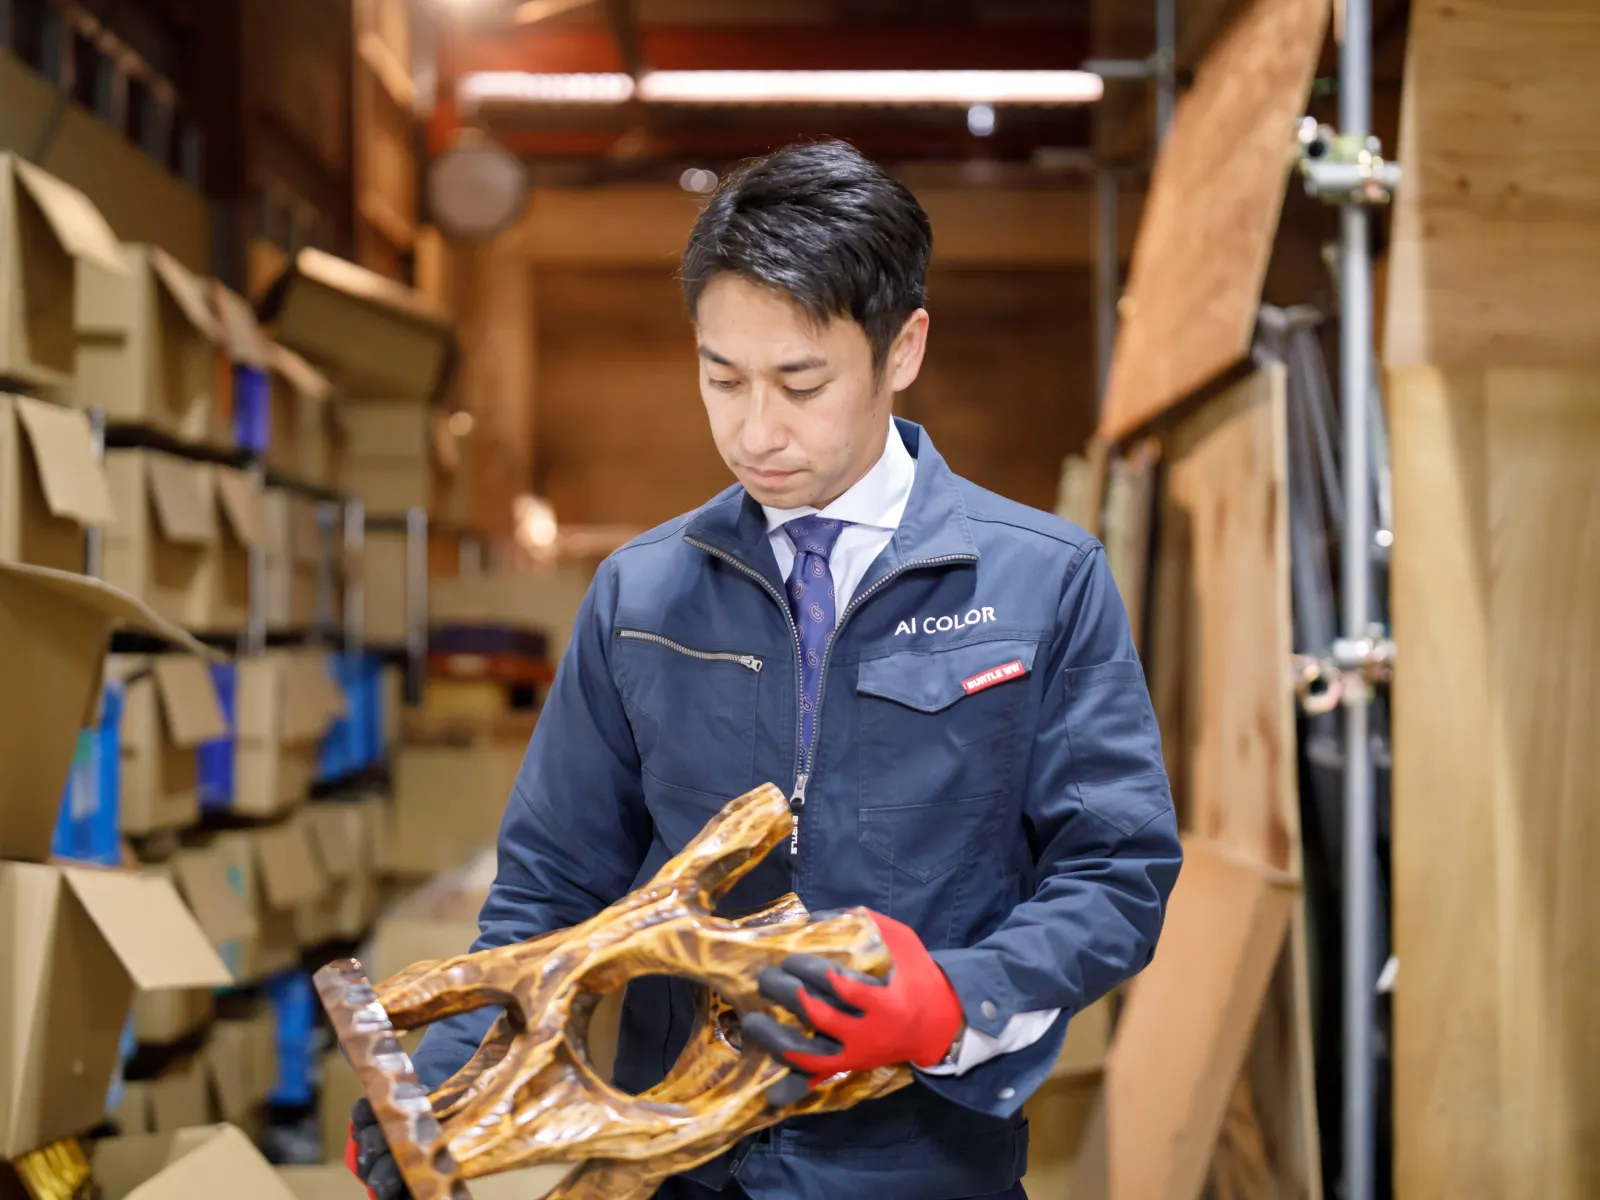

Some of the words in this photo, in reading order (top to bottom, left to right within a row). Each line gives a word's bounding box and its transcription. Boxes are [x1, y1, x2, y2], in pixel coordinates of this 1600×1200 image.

[894, 617, 916, 636] AI
[923, 606, 997, 635] COLOR
[966, 669, 1004, 690] BURTLE
[1002, 662, 1020, 675] WW
